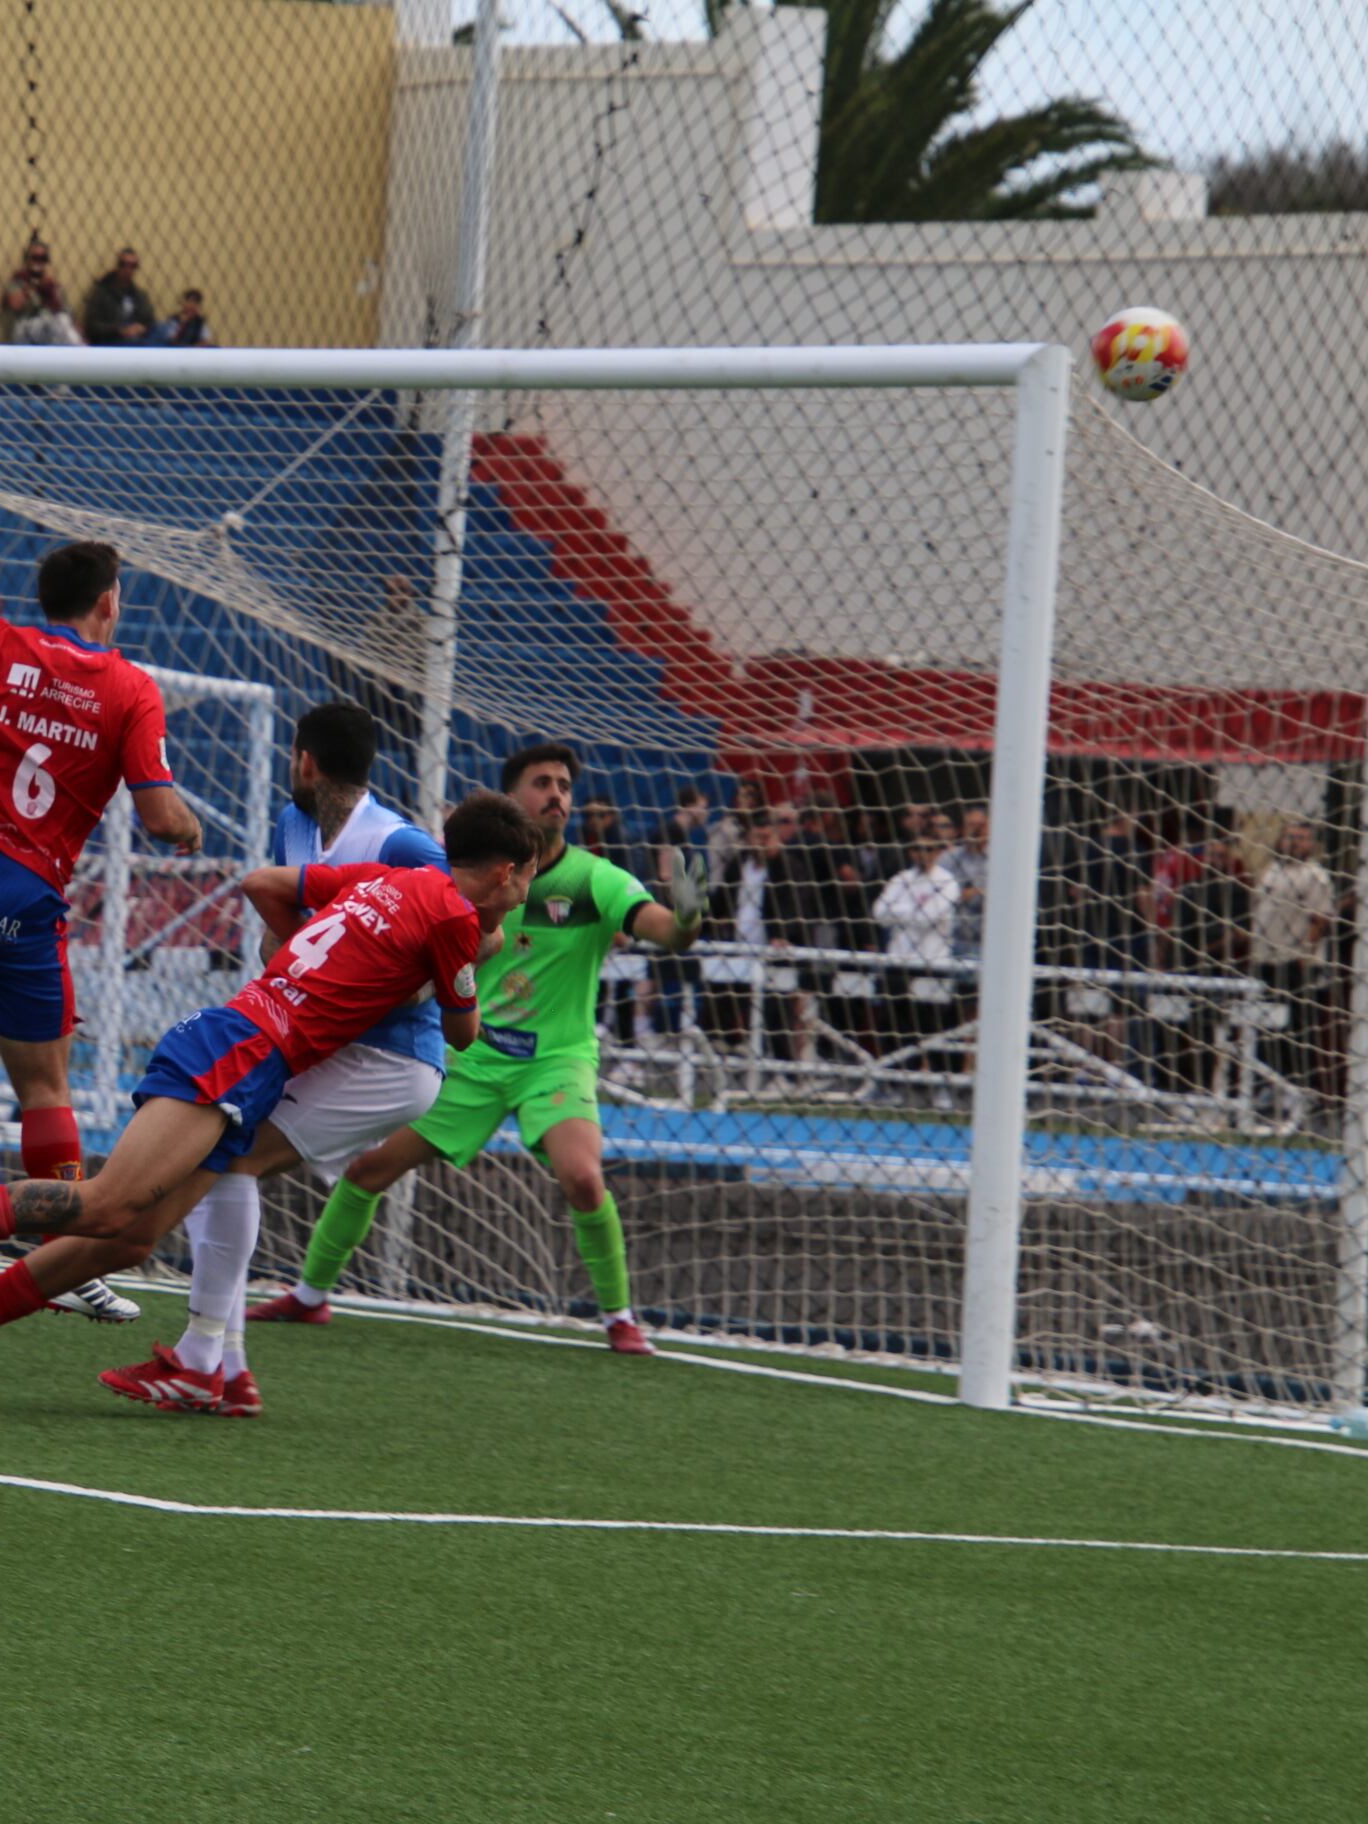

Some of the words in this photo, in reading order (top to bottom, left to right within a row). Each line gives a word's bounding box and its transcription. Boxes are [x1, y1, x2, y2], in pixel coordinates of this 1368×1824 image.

[40, 687, 101, 714] ARRECIFE
[52, 678, 95, 699] TURISMO
[17, 711, 98, 751] MARTIN
[12, 742, 56, 819] 6
[288, 911, 346, 979] 4
